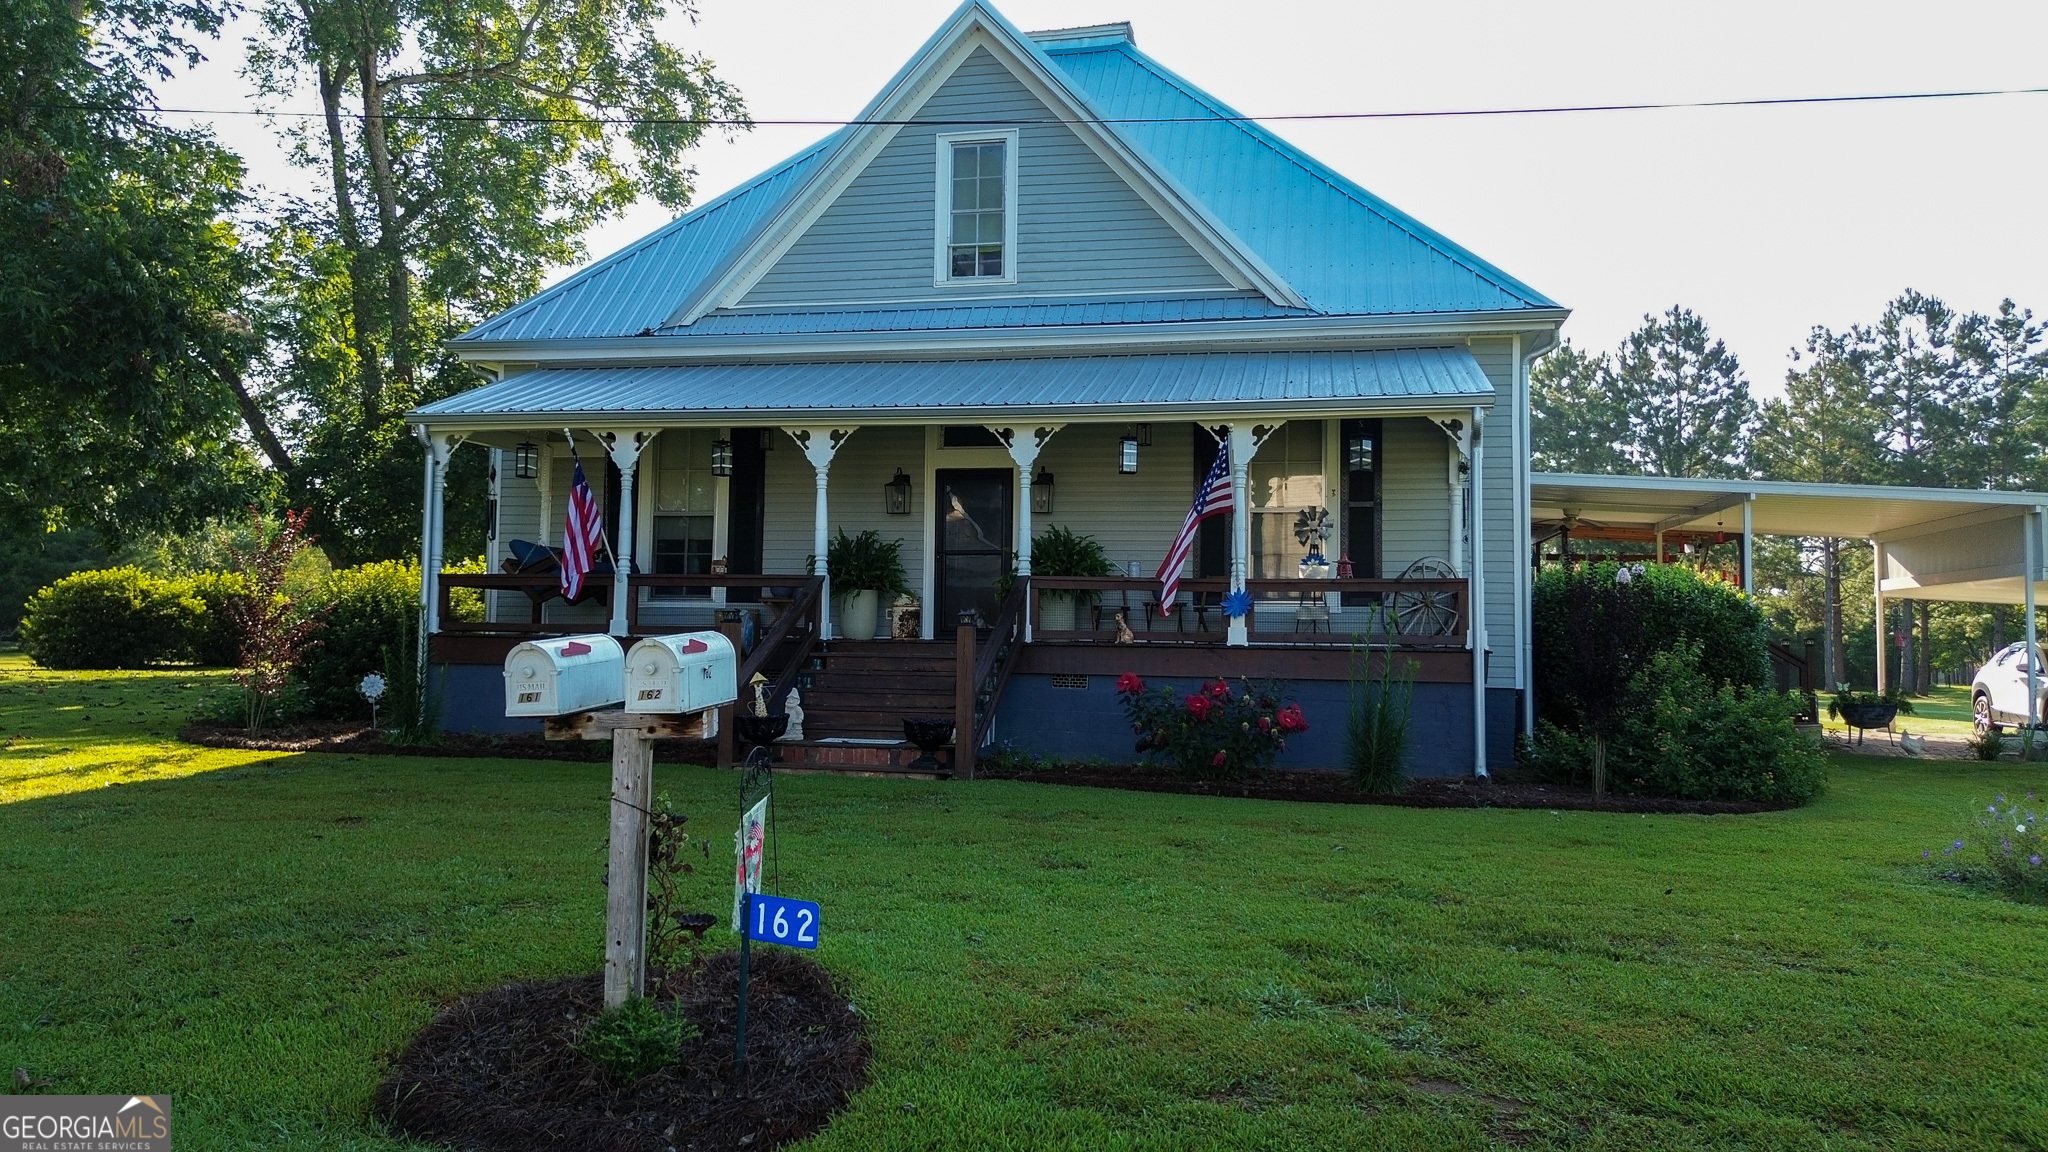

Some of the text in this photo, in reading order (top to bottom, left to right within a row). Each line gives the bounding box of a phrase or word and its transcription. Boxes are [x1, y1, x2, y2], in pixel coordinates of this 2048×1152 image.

[520, 693, 539, 703] 161
[641, 690, 661, 700] 162
[758, 903, 814, 942] 162
